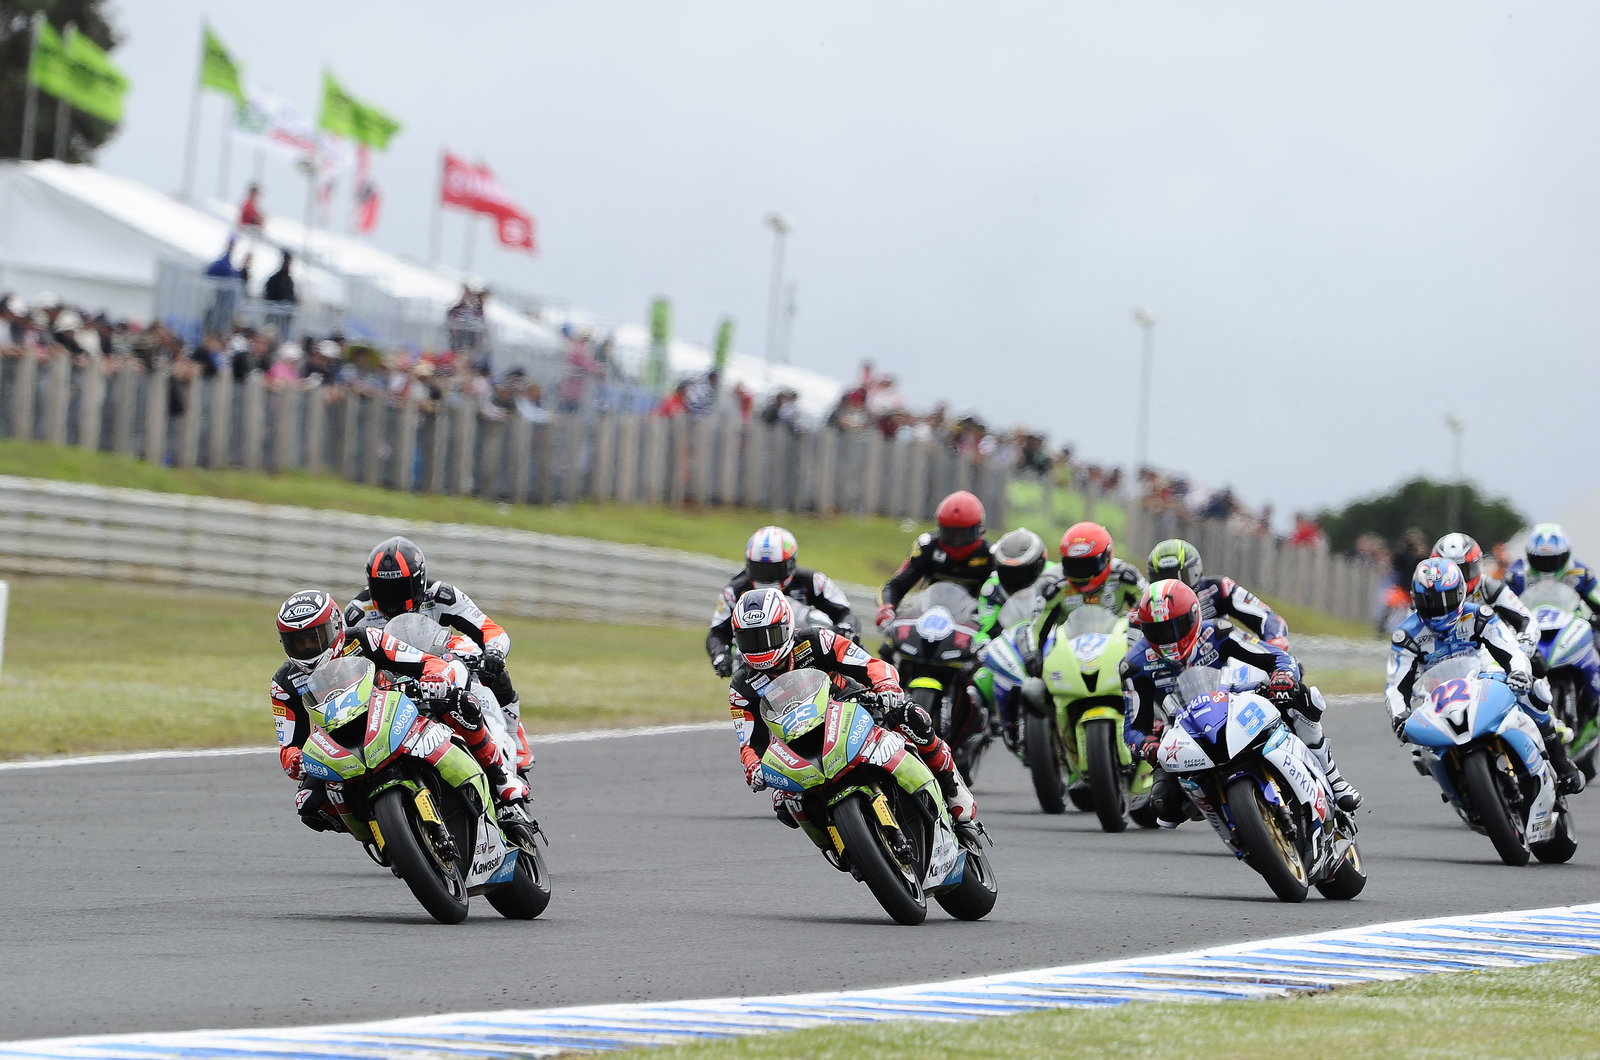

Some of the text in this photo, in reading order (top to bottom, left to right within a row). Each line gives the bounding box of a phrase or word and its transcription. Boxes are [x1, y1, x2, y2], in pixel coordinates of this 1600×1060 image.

[745, 612, 763, 620] Arai
[324, 691, 361, 724] 44
[369, 692, 384, 732] Motocard
[1431, 678, 1471, 713] 22
[780, 703, 818, 737] 23
[827, 704, 840, 744] Motocard
[1237, 702, 1266, 736] 9
[312, 731, 340, 756] Motocard
[770, 742, 799, 766] Motocard
